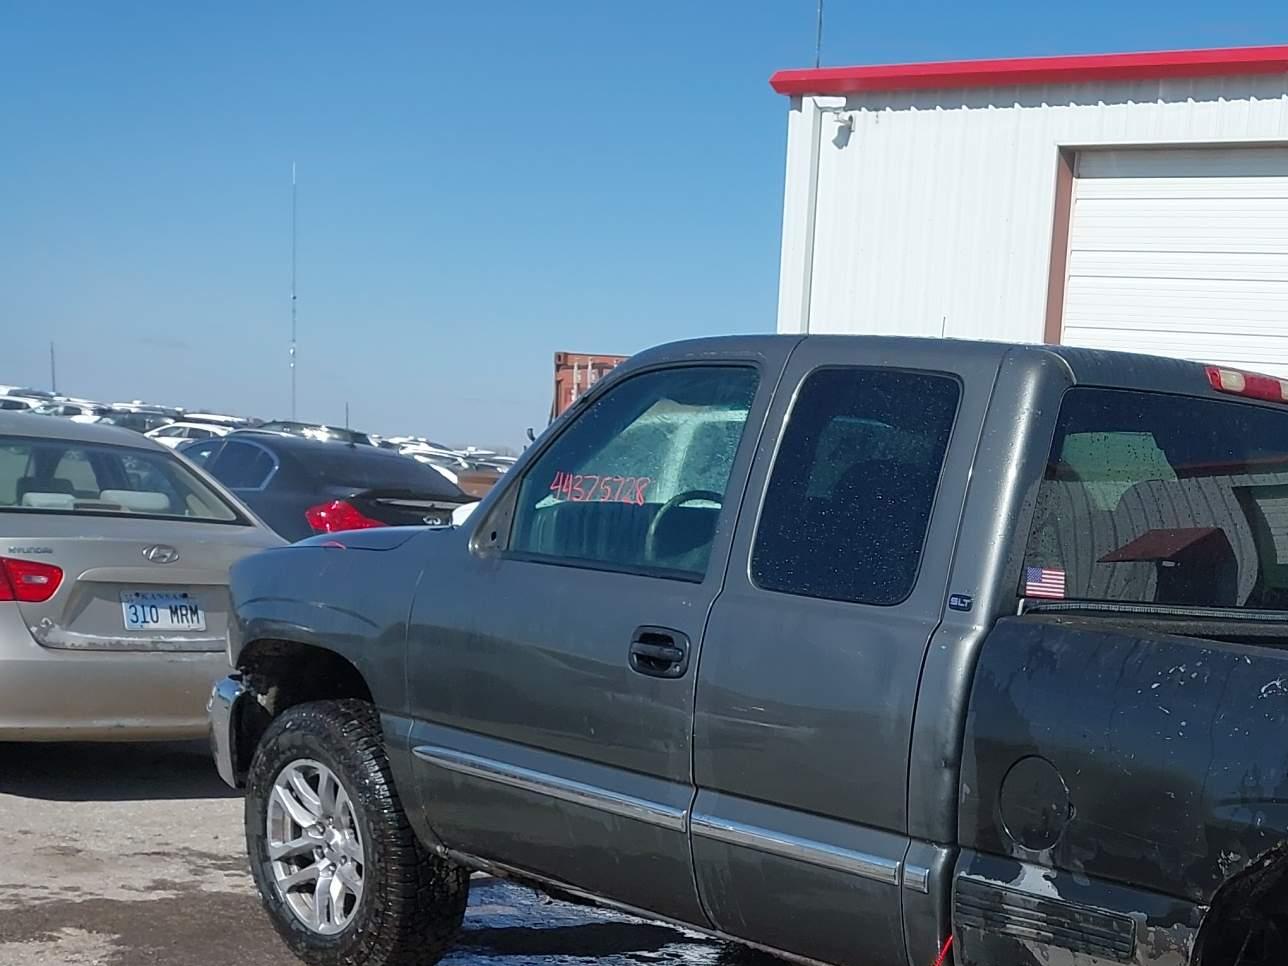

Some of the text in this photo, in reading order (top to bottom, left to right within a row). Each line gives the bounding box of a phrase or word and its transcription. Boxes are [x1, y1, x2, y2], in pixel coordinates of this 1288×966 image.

[550, 471, 651, 506] 44375728
[949, 597, 970, 608] SLT
[128, 604, 200, 625] 310 MRM
